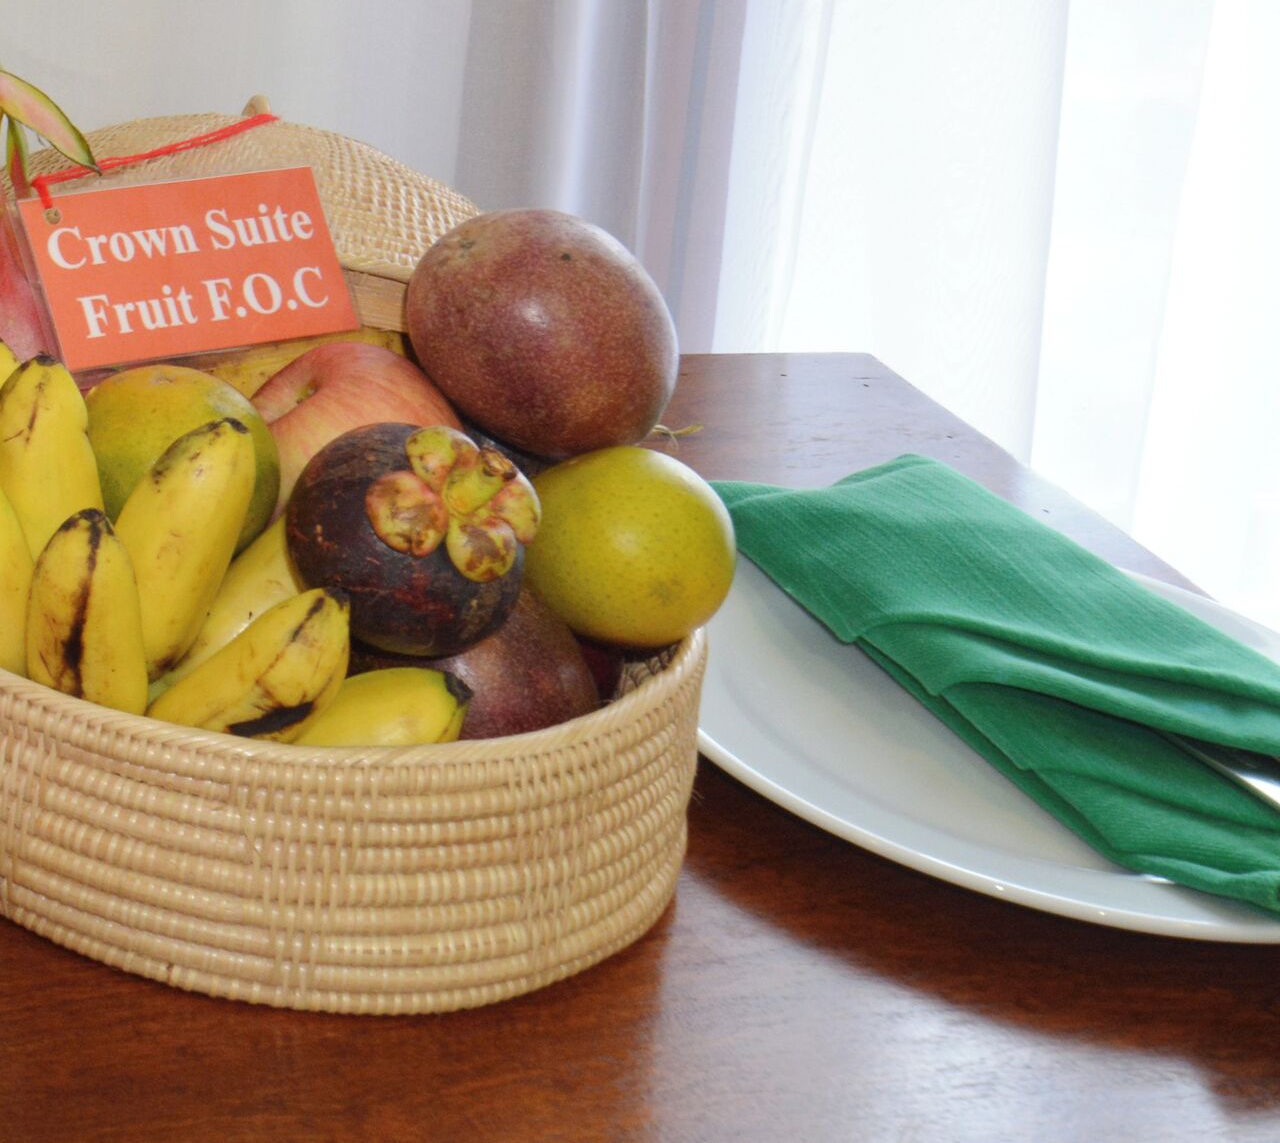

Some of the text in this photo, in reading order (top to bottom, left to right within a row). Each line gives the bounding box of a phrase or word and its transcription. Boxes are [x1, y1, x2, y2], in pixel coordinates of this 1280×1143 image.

[46, 203, 315, 271] Crown Suite
[76, 266, 330, 339] Fruit F.O.C
